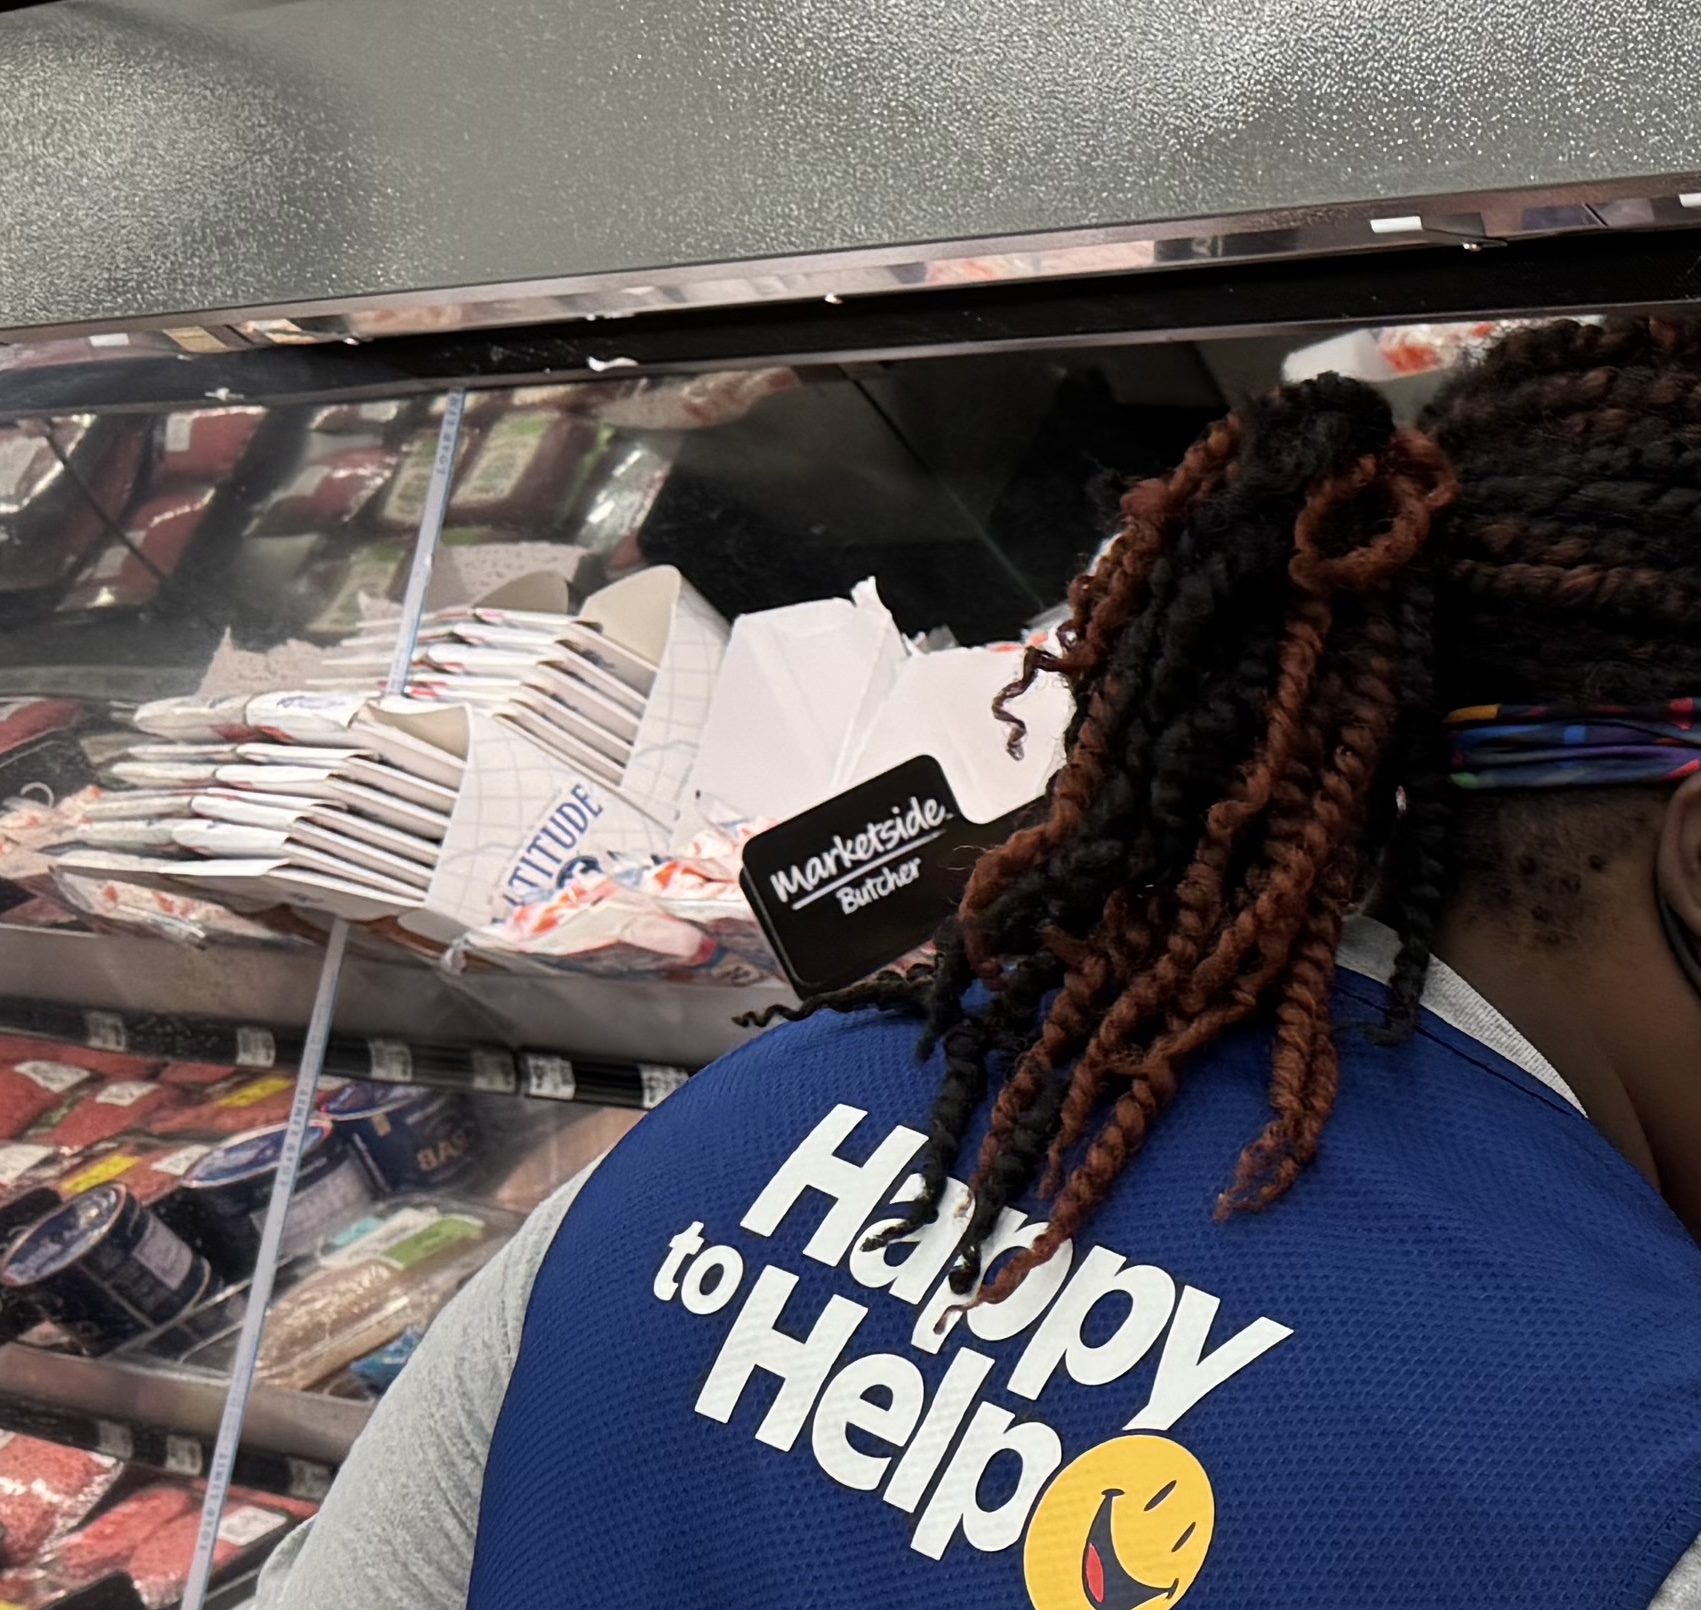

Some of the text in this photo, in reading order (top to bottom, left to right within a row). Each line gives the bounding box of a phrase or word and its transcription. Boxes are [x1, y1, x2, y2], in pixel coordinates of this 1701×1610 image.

[770, 795, 954, 903] Marketside
[835, 857, 923, 916] Butcher
[653, 1222, 744, 1315] to
[741, 1103, 1294, 1431] Happy
[695, 1266, 1062, 1560] Help
